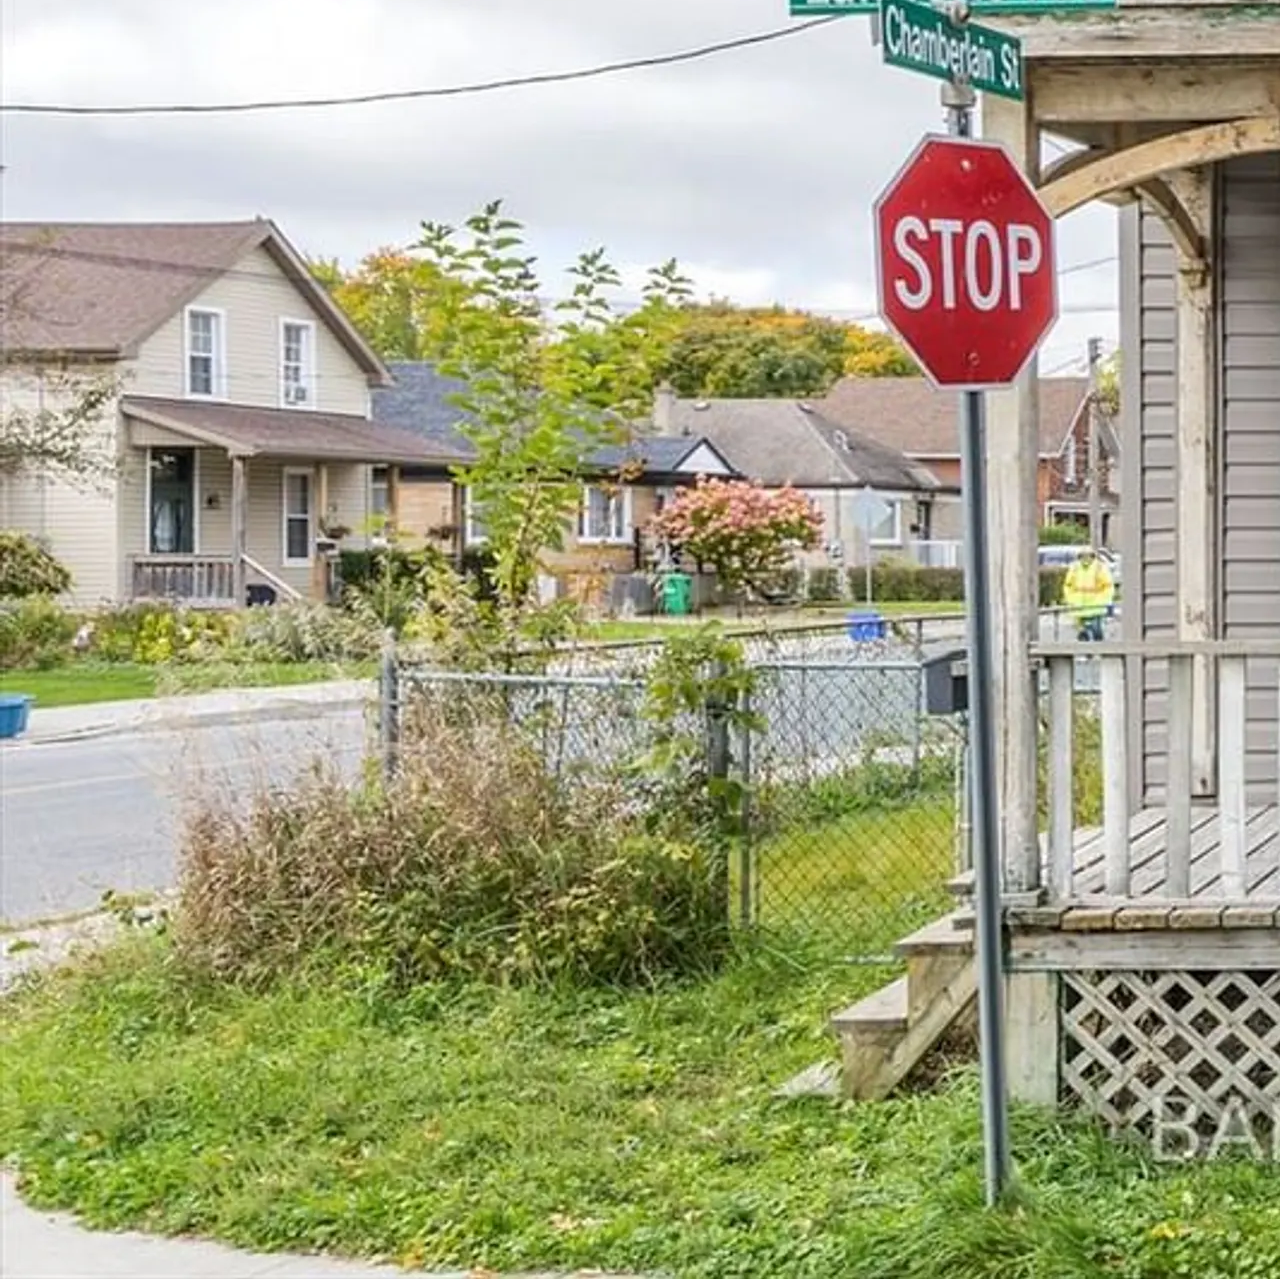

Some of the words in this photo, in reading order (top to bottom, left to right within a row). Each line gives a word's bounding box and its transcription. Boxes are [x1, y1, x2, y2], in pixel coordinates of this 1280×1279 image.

[885, 4, 995, 82] Chamberlain
[1000, 43, 1021, 90] St
[893, 215, 1042, 312] STOP
